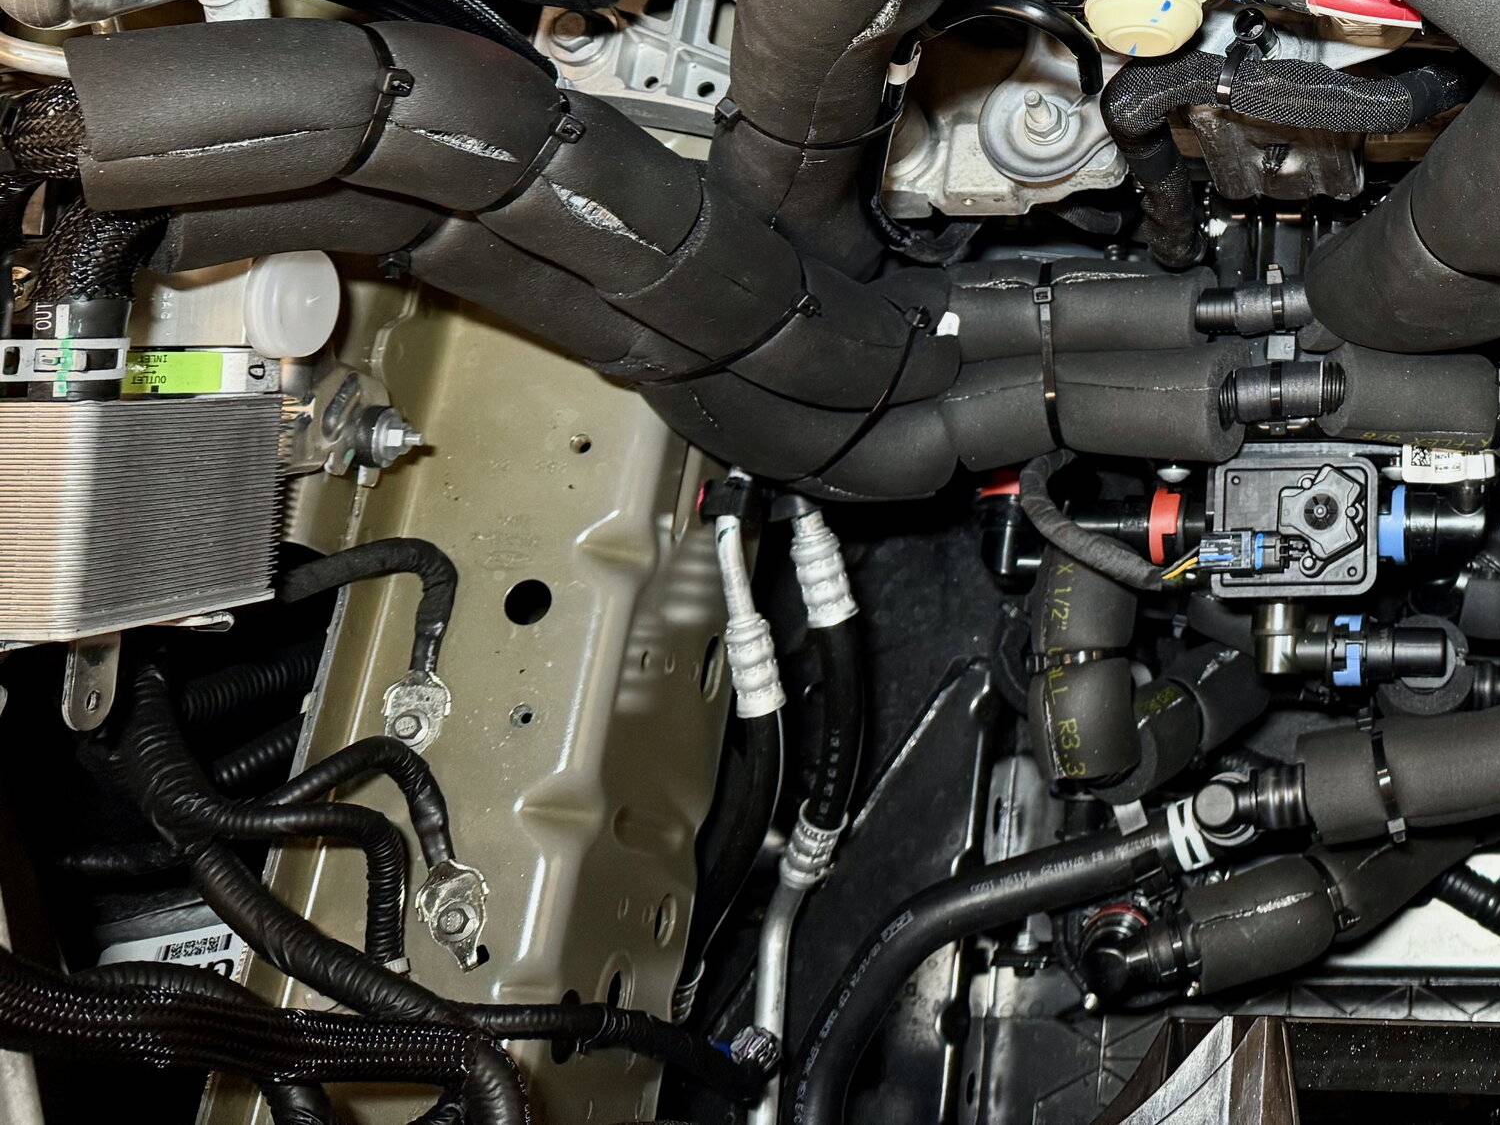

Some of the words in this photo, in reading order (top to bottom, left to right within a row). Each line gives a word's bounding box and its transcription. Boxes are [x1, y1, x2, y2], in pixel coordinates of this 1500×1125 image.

[34, 301, 53, 332] OUT
[137, 353, 168, 365] INLET
[130, 375, 167, 385] OUTLET
[1056, 562, 1074, 575] X
[1050, 585, 1074, 632] 1/2"
[1056, 717, 1089, 777] R3.3
